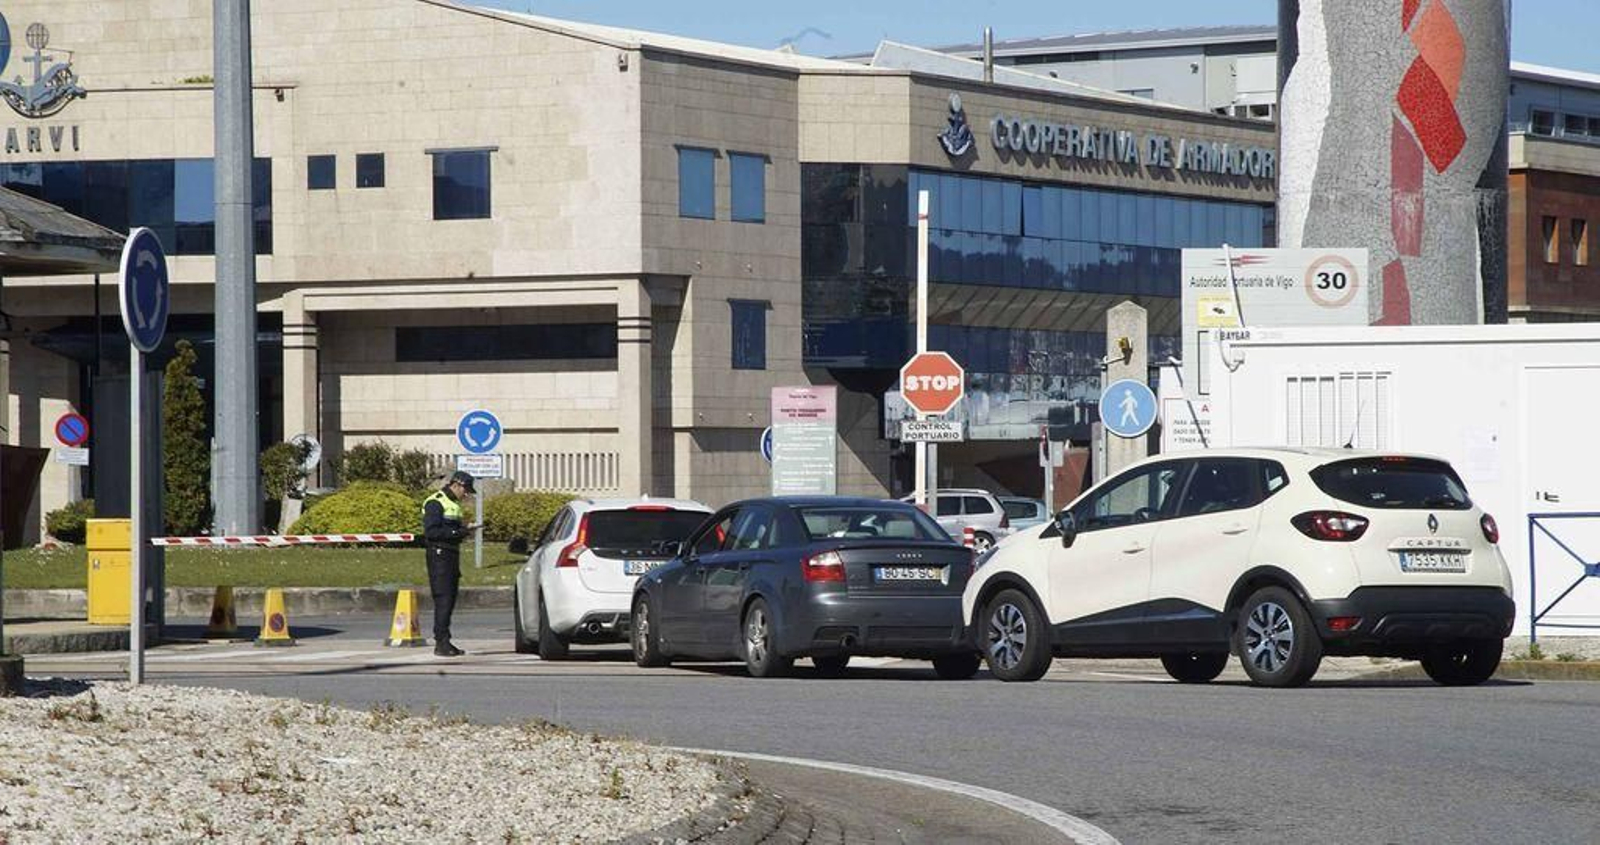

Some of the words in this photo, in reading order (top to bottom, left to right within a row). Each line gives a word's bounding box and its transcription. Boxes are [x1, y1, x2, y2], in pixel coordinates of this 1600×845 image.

[5, 125, 79, 153] ARVI
[991, 115, 1139, 164] COOPERATIVA
[1146, 134, 1172, 168] DE
[1189, 276, 1227, 288] Autoridad
[1264, 277, 1274, 287] de
[1276, 276, 1294, 290] Vigo
[1316, 272, 1346, 290] 30
[905, 375, 960, 391] STOP
[1407, 553, 1437, 567] 7535
